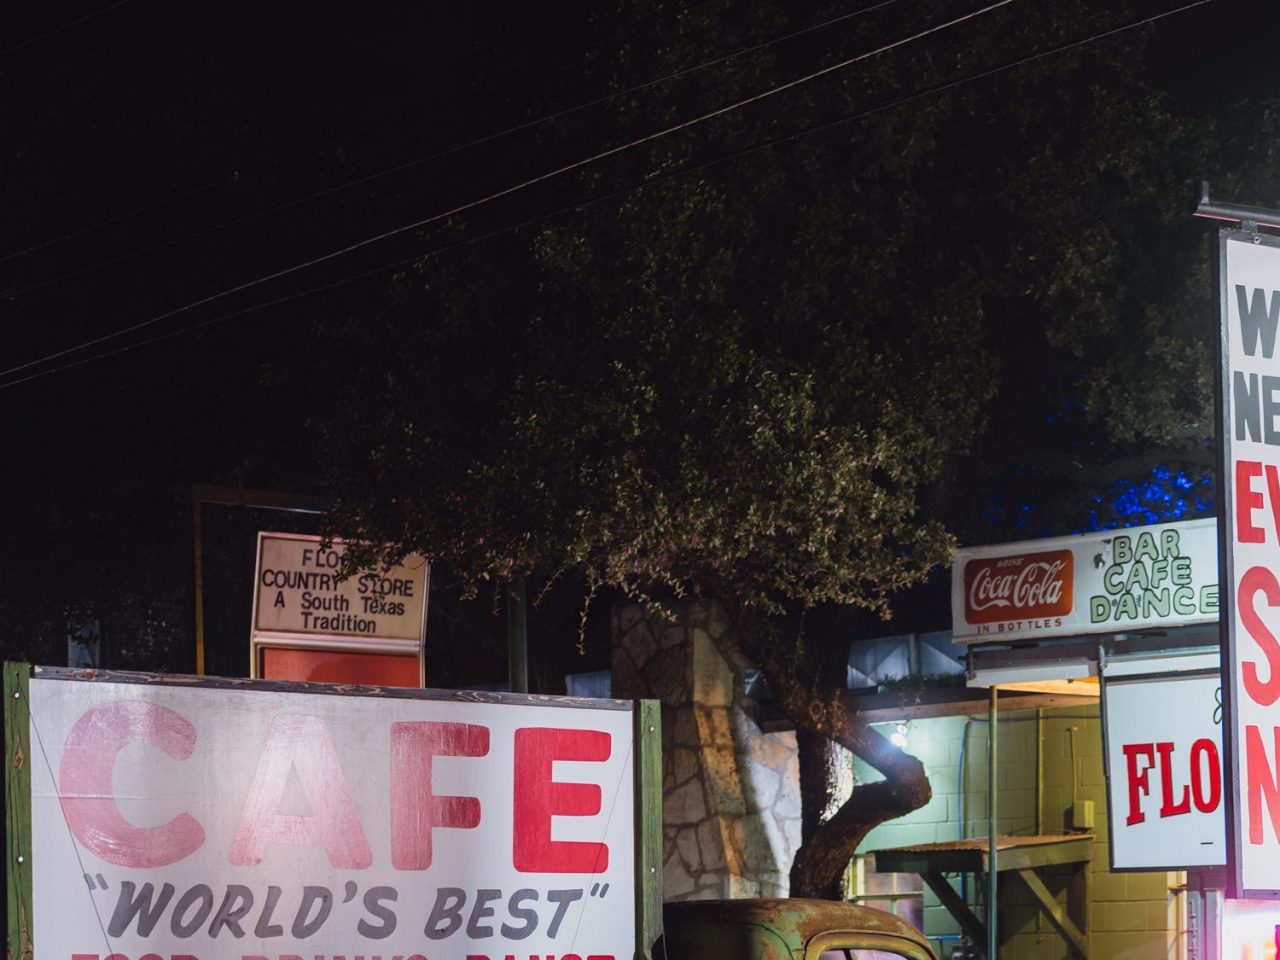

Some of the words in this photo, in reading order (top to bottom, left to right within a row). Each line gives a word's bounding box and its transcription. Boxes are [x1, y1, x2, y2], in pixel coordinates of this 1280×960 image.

[1112, 529, 1180, 565] BAR
[261, 569, 340, 592] COUNTRY
[357, 574, 415, 597] STORE
[970, 560, 1068, 611] Coca-Cola
[1104, 556, 1192, 596] CAFE
[273, 591, 286, 608] A
[300, 592, 349, 612] South
[360, 596, 405, 615] Texas
[1090, 584, 1219, 624] DANCE
[300, 612, 377, 633] Tradition
[977, 626, 990, 634] IN
[998, 618, 1063, 632] BOTTLES
[58, 701, 612, 874] CAFE
